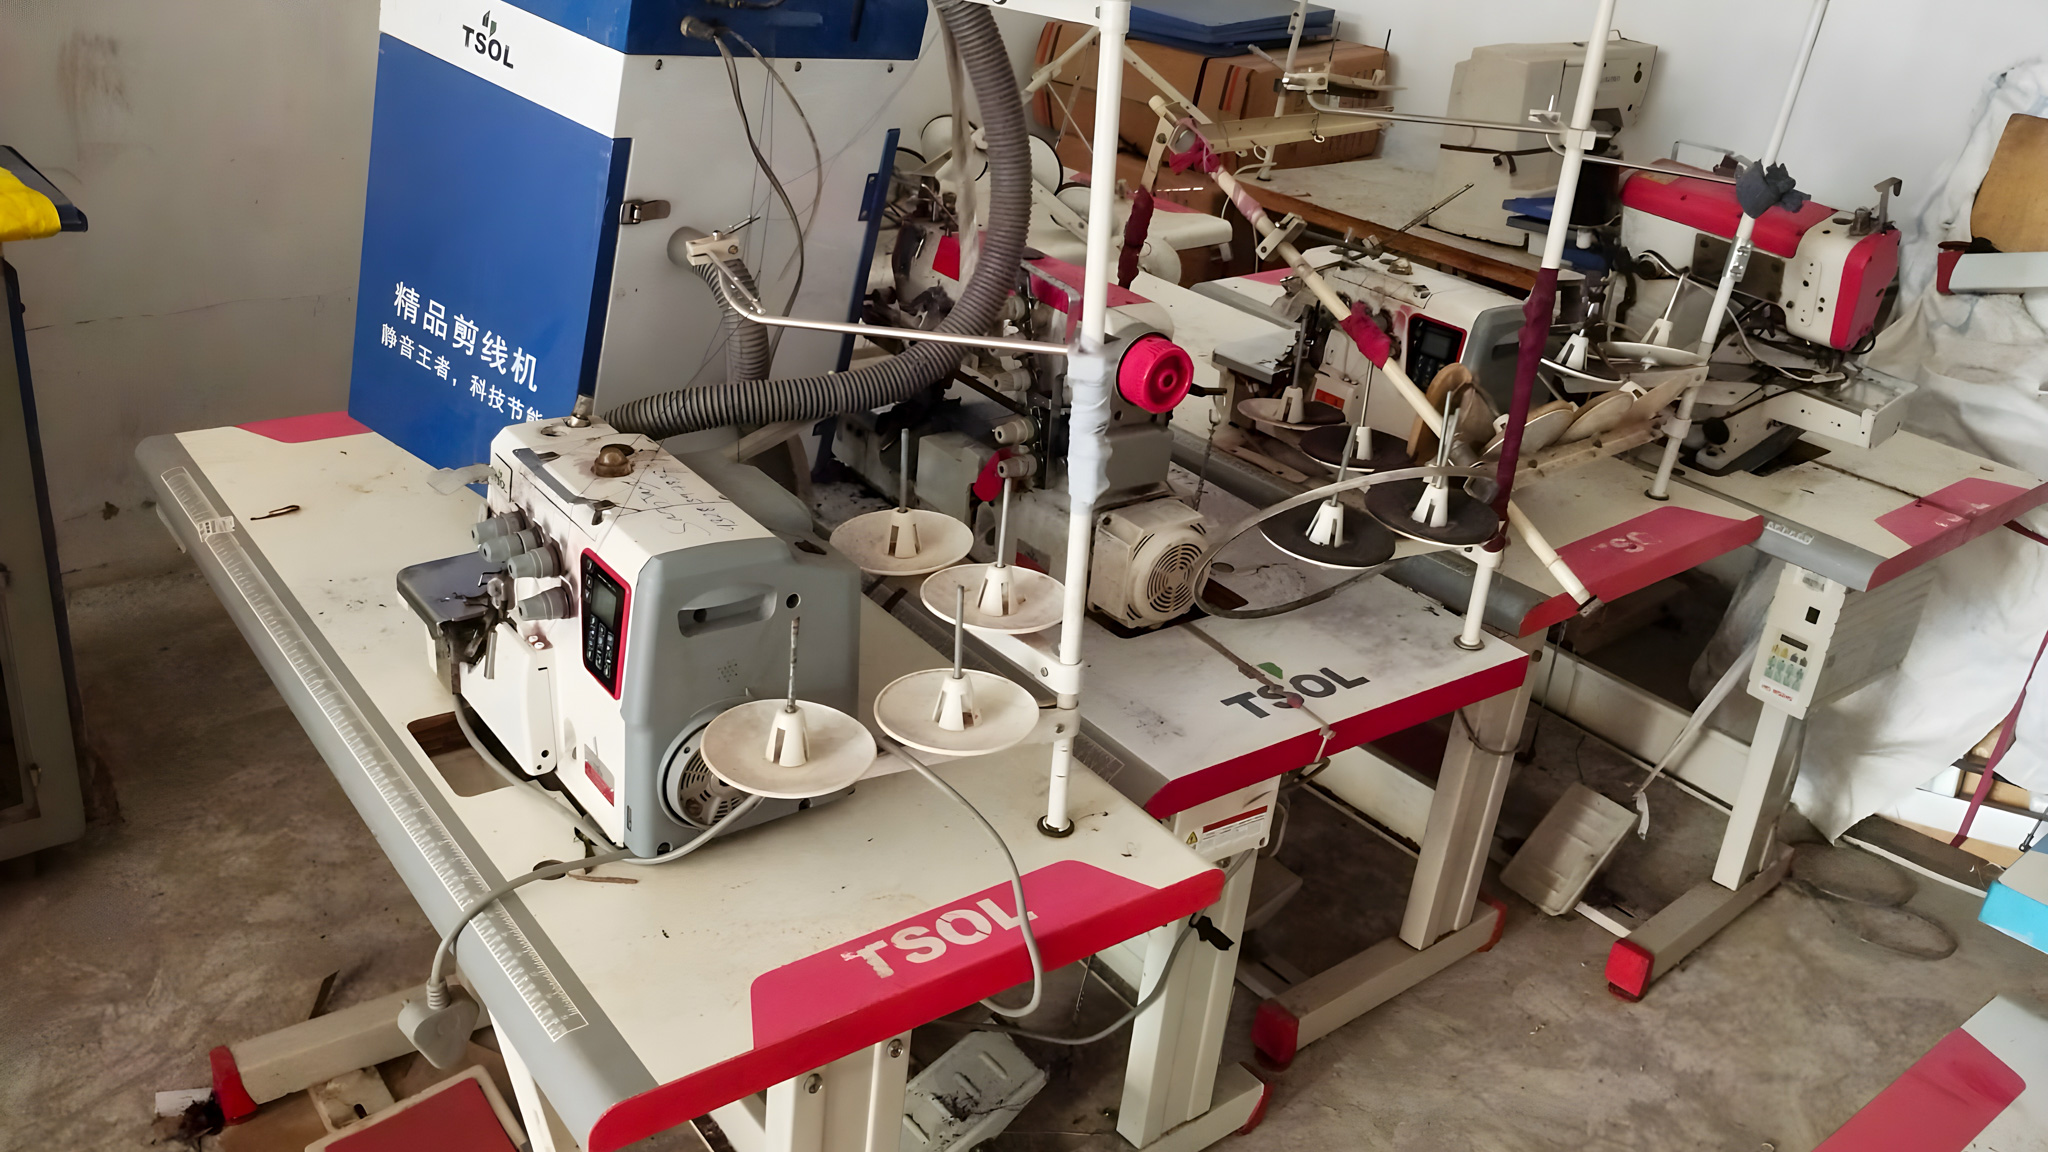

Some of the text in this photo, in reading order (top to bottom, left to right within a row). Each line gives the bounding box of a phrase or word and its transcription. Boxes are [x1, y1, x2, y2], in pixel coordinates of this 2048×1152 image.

[462, 24, 514, 69] TSOL
[394, 281, 538, 392] 精品剪线机
[1220, 667, 1370, 718] TSOL
[840, 898, 1039, 979] TSOL
